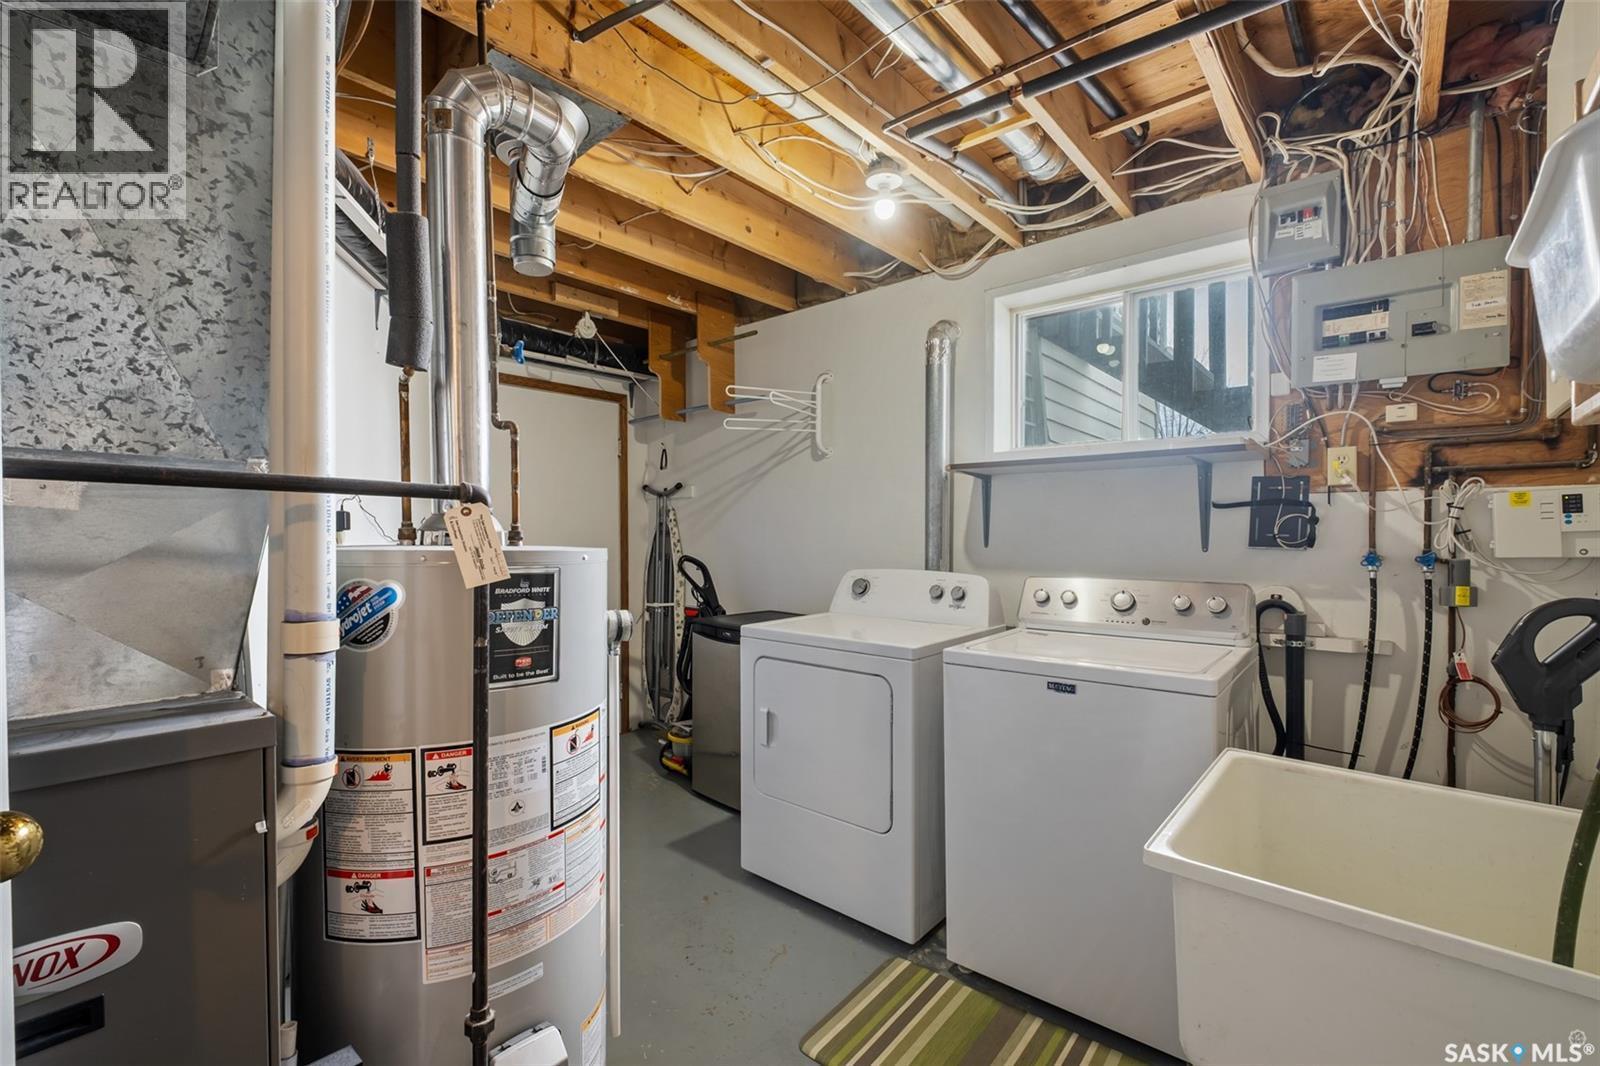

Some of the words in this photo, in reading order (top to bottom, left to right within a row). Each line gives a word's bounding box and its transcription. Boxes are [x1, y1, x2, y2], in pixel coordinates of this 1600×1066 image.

[494, 587, 530, 595] BRADFORD
[339, 602, 373, 637] ydrojet
[488, 607, 559, 624] DEFENDER
[440, 750, 468, 758] DANGER
[357, 871, 382, 879] DANGER
[13, 943, 86, 986] NOX
